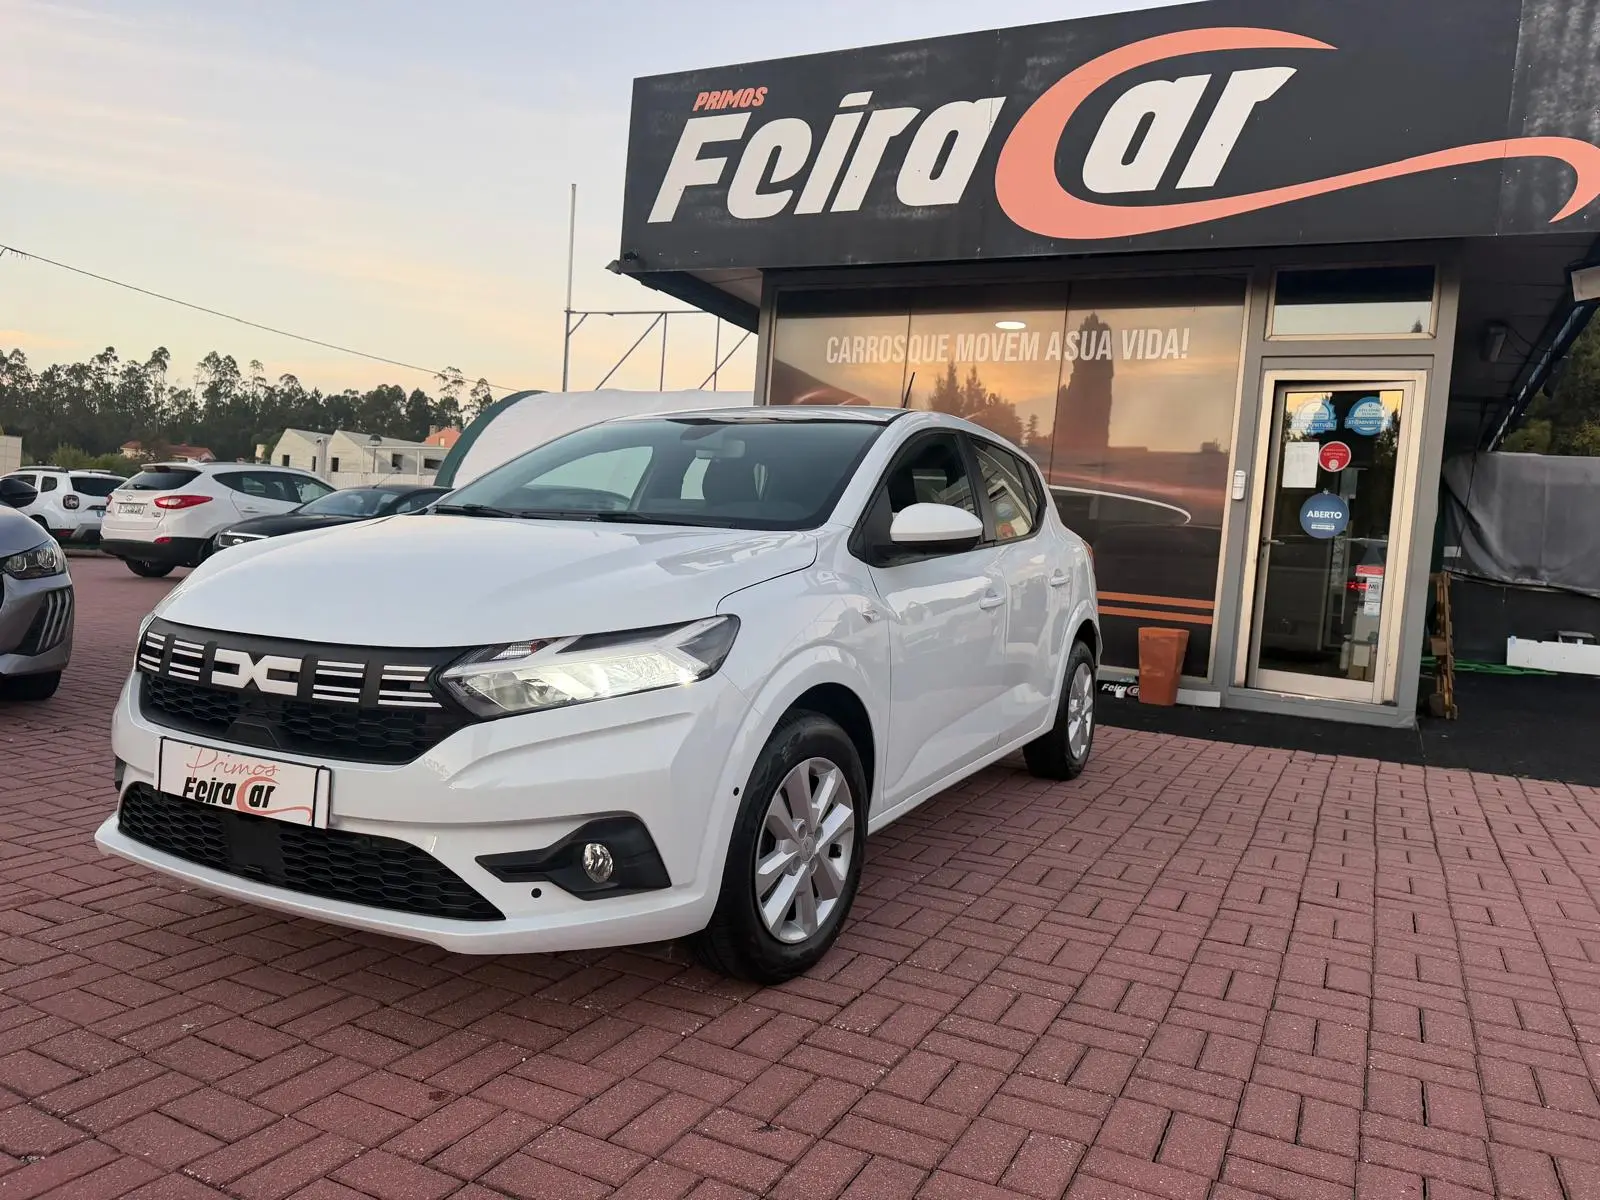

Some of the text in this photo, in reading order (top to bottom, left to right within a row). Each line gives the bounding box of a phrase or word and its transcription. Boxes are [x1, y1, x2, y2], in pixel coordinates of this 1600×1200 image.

[692, 86, 768, 112] PRIMOS
[955, 332, 1041, 362] MOVEM
[1045, 331, 1062, 361] A
[1064, 329, 1112, 361] SUA
[1121, 328, 1190, 360] VIDA!
[1306, 510, 1343, 520] ABERTO
[186, 746, 281, 783] Primos
